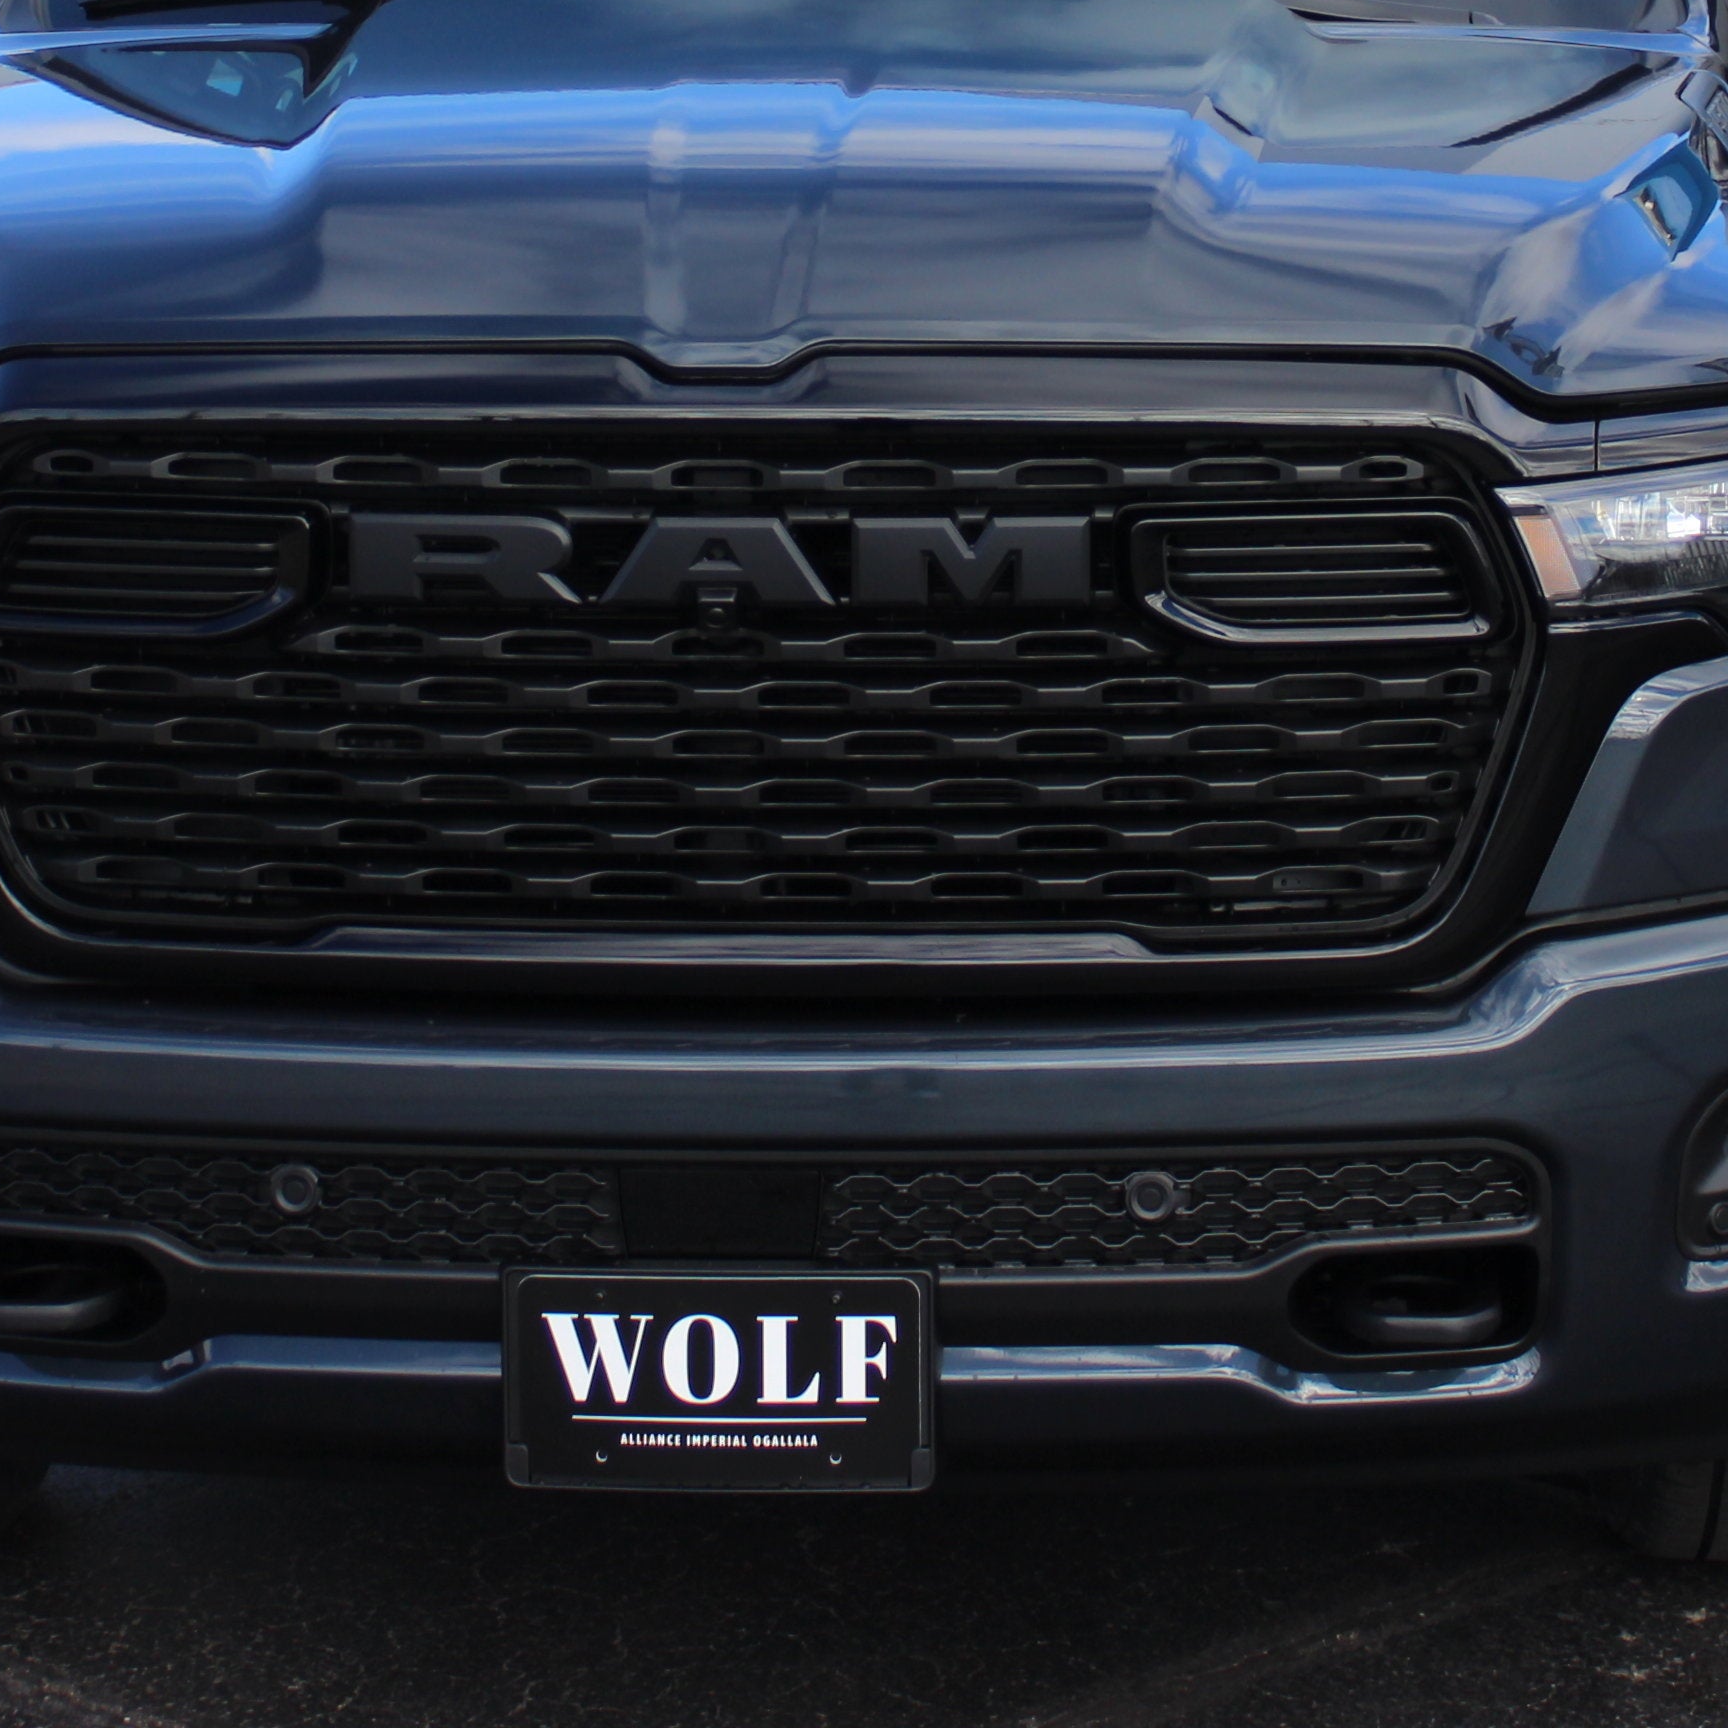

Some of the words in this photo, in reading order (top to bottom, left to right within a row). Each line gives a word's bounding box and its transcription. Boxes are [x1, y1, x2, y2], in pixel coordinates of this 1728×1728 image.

[348, 511, 1091, 606] RAM
[541, 1312, 898, 1405] WOLF
[620, 1432, 681, 1447] ALLIANCE
[686, 1434, 748, 1447] IMPERIAL
[753, 1434, 818, 1448] OGALLALA
